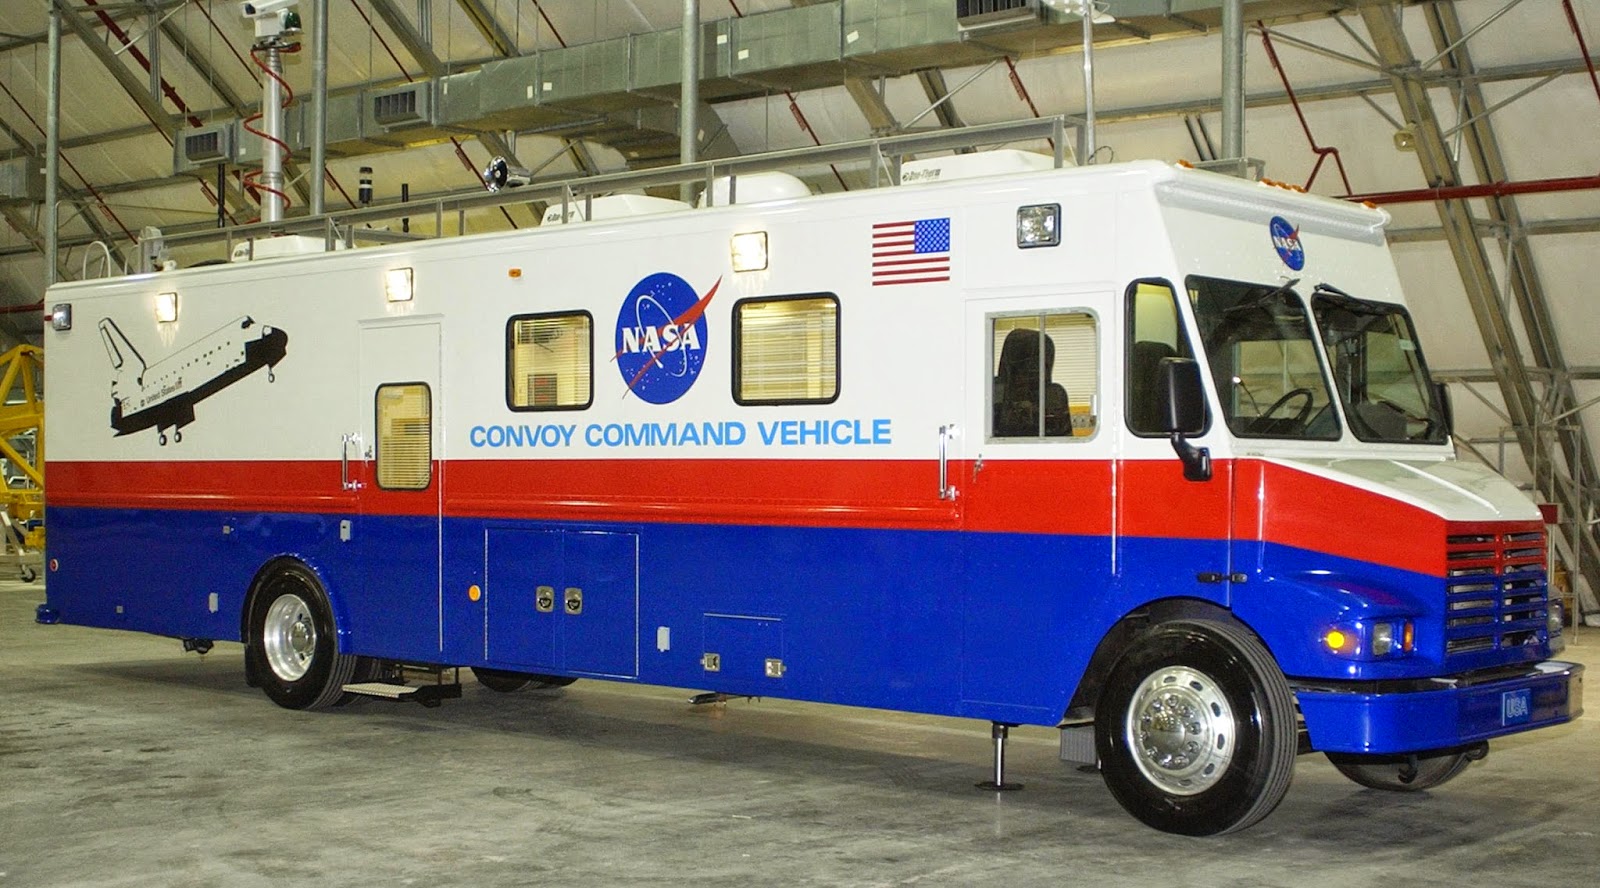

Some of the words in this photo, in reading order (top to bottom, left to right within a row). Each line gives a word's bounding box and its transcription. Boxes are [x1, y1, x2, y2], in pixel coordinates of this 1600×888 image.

[1273, 235, 1302, 251] NASA
[621, 322, 701, 354] NASA
[469, 424, 577, 447] CONVOY
[585, 422, 747, 447] COMMAND
[757, 419, 892, 446] VEHICLE
[1506, 695, 1529, 718] USA
